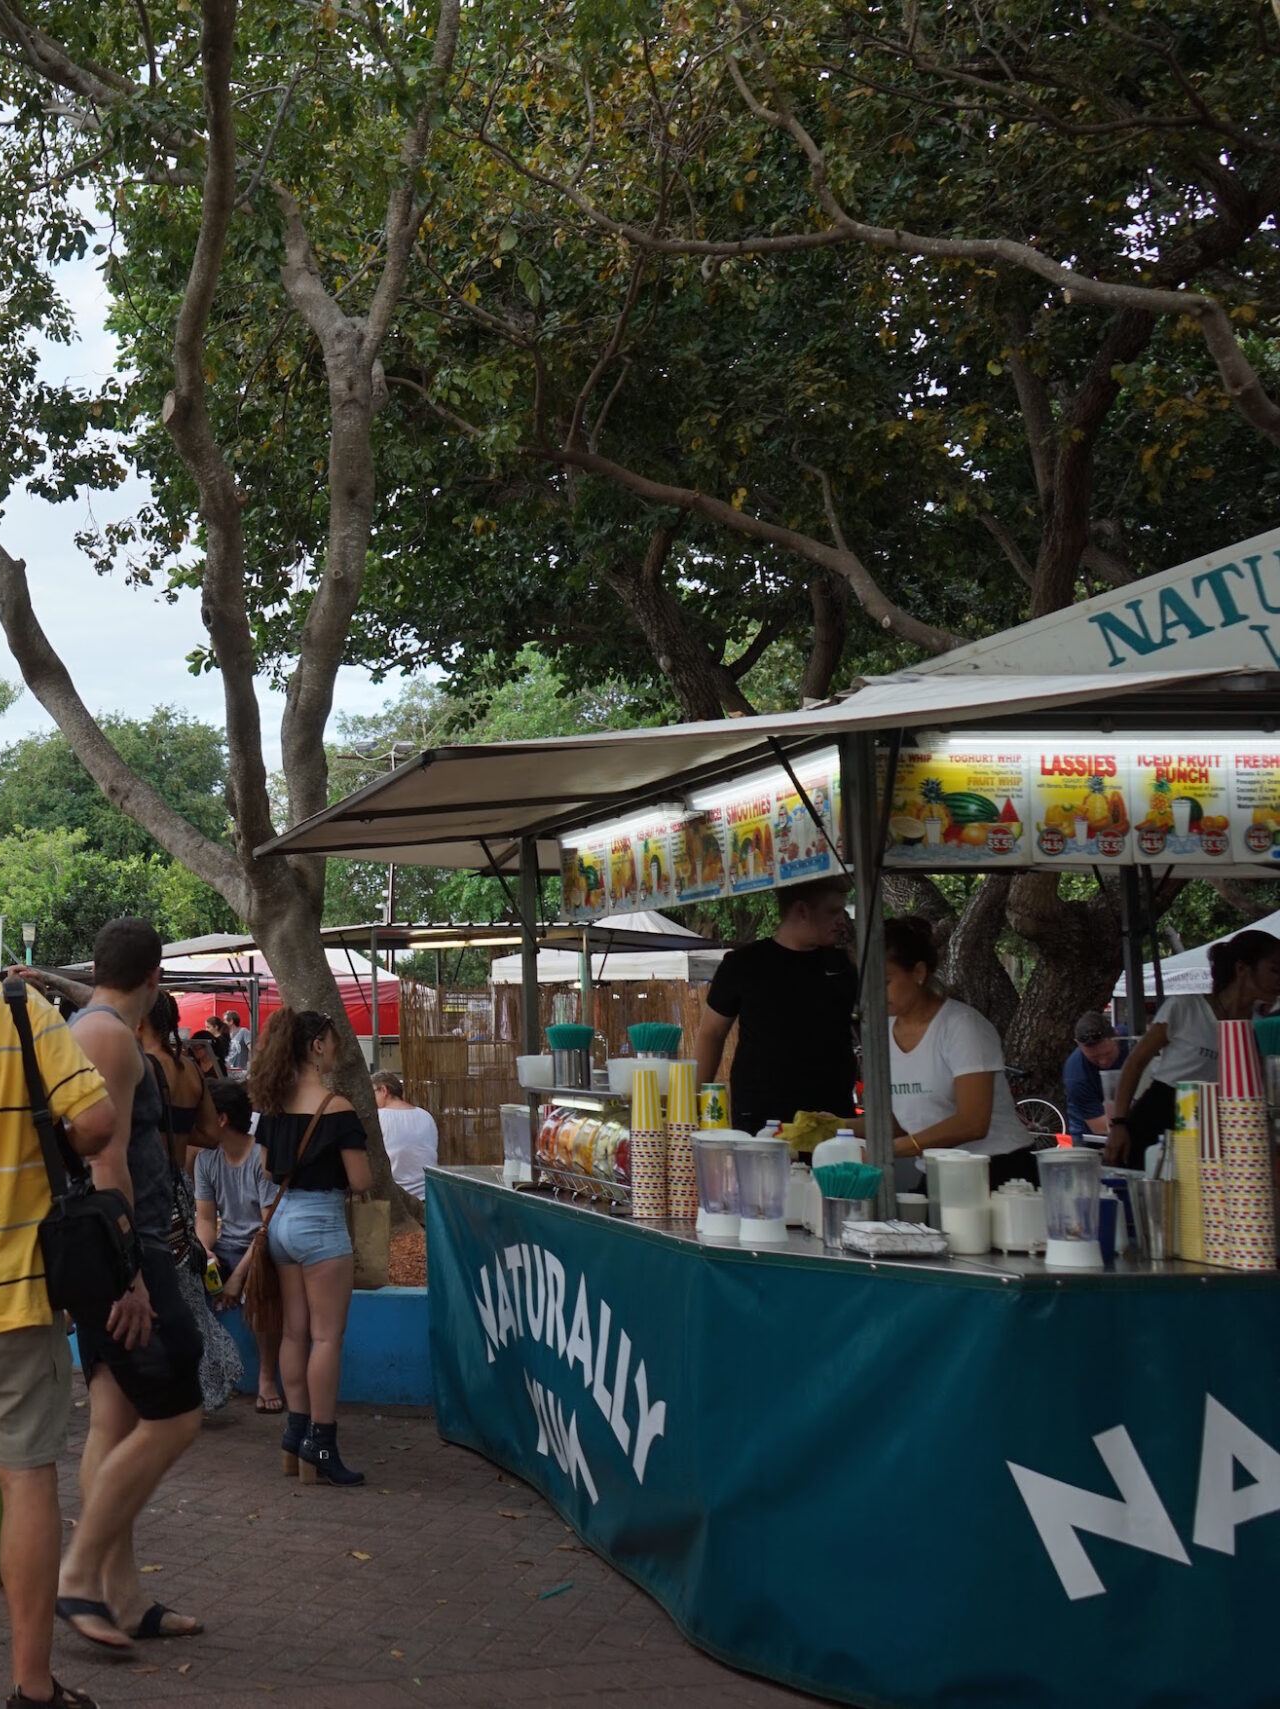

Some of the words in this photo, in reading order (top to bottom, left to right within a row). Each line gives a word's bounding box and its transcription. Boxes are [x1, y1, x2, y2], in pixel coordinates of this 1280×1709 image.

[949, 754, 994, 763] YOGHURT
[997, 754, 1023, 763] WHIP
[1040, 754, 1117, 777] LASSIES
[1137, 754, 1173, 767] ICED
[1177, 754, 1222, 768] FRUIT
[967, 776, 994, 786] FRUIT
[998, 776, 1023, 786] WHIP
[1155, 767, 1209, 784] PUNCH
[473, 1243, 666, 1486] NATURALLY
[524, 1367, 599, 1505] YUM
[1005, 1391, 1280, 1601] NA
